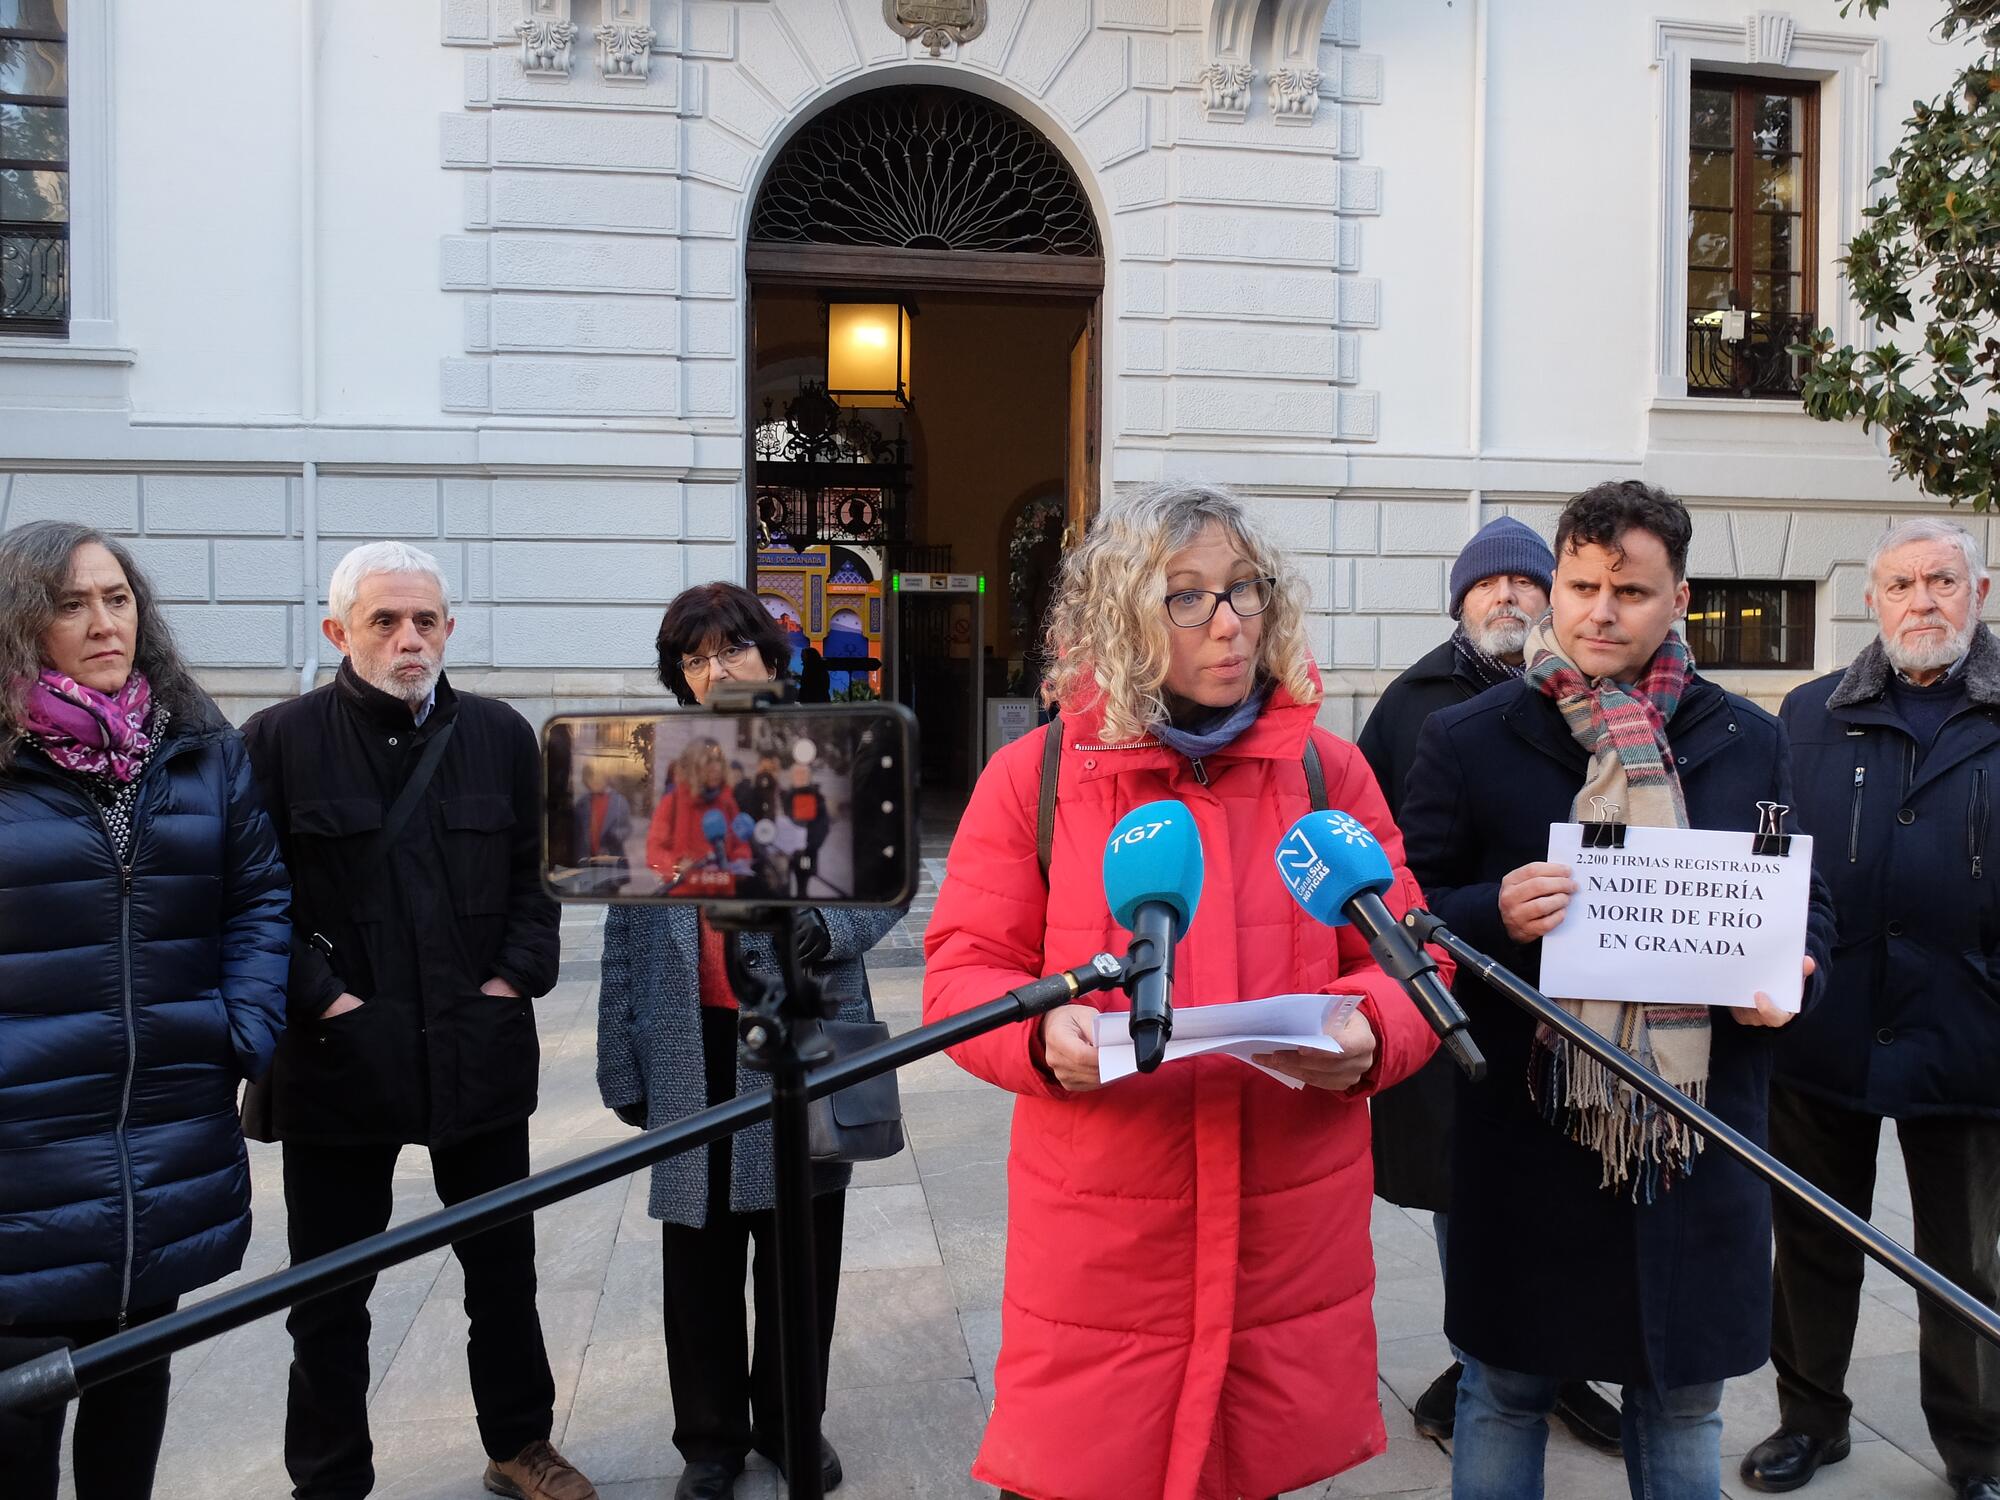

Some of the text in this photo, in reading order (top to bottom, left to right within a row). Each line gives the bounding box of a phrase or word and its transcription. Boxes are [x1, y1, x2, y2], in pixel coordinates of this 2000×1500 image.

[1110, 821, 1165, 854] TG7
[1576, 853, 1780, 875] 2.200 FIRMAS REGISTRADAS
[1302, 866, 1330, 903] NOTICIAS
[1587, 876, 1764, 901] NADIE DEBERÍA
[1587, 904, 1763, 929] MORIR DE FRÍO
[1599, 933, 1746, 957] EN GRANADA
